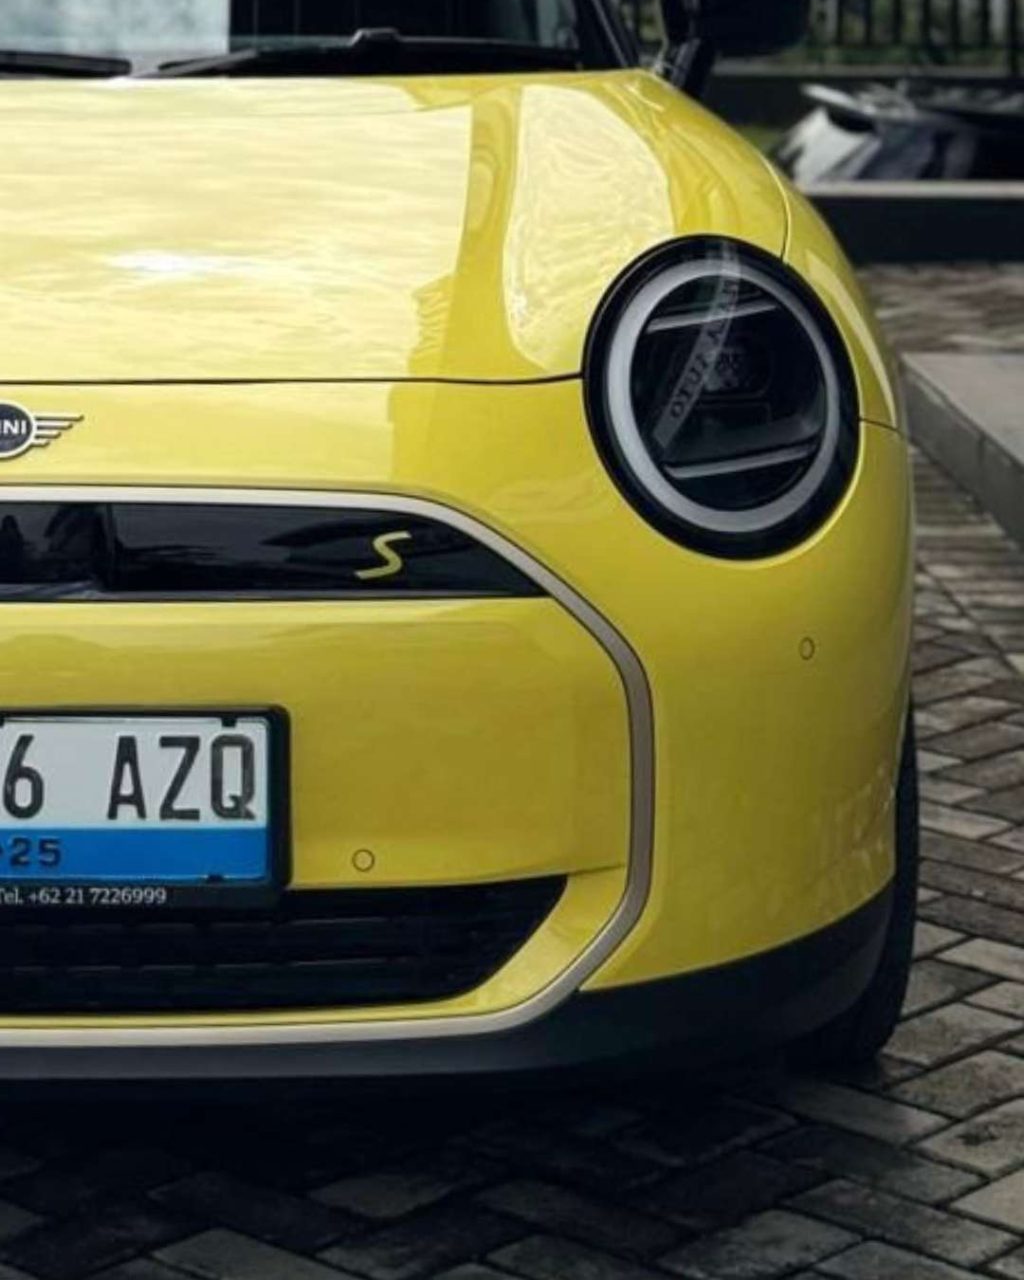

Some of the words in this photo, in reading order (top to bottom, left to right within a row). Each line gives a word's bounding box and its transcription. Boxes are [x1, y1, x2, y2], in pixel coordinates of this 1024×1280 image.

[355, 529, 412, 581] S
[106, 734, 257, 822] AZQ
[28, 886, 61, 905] +62
[64, 886, 84, 905] 21
[88, 886, 168, 905] 7226999
